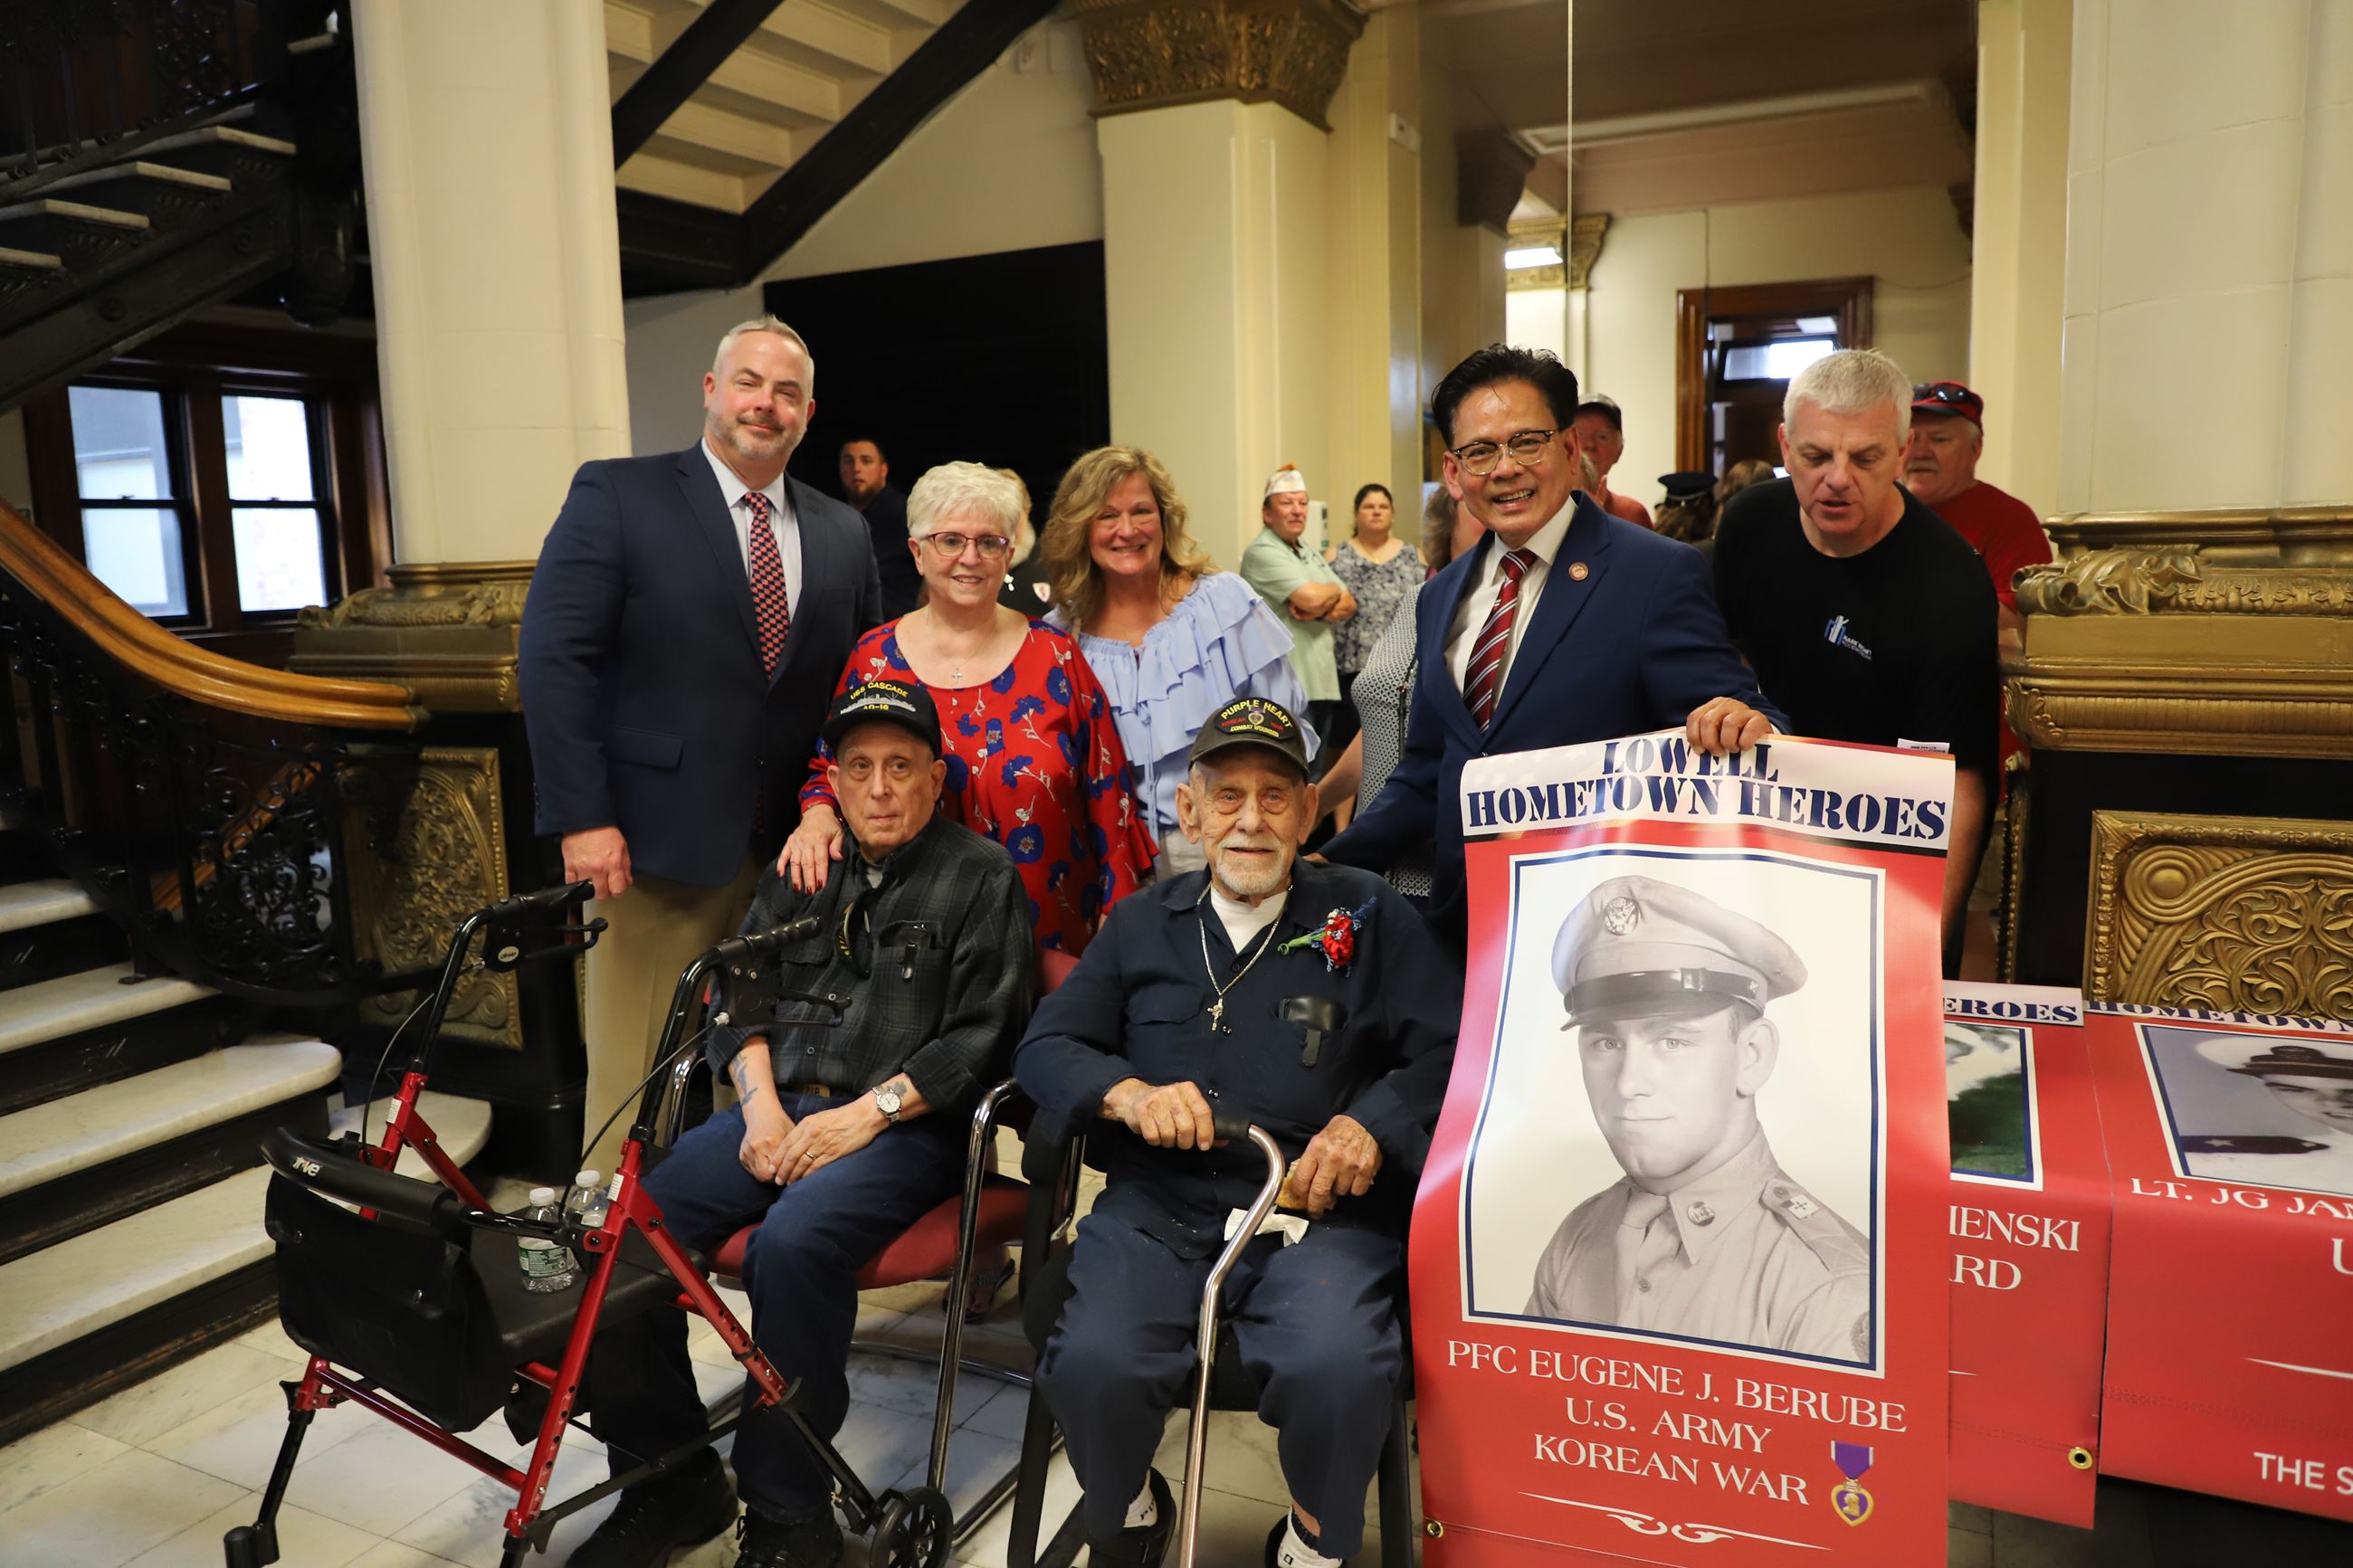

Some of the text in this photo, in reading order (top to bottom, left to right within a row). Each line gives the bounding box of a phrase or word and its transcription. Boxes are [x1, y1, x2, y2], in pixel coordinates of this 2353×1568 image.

[851, 686, 865, 700] USS
[1221, 699, 1293, 728] PURPLE HEART
[1602, 736, 1778, 782] LOWELL
[1467, 775, 1946, 840] HOMETOWN HEROES
[2130, 1178, 2193, 1201] LT.
[2211, 1188, 2269, 1209] JG
[1448, 1340, 1907, 1432] PFC EUGENE J. BERUBE
[1566, 1397, 1772, 1453] U.S. ARMY
[1534, 1434, 1809, 1506] KOREAN WAR
[2253, 1451, 2326, 1490] THE
